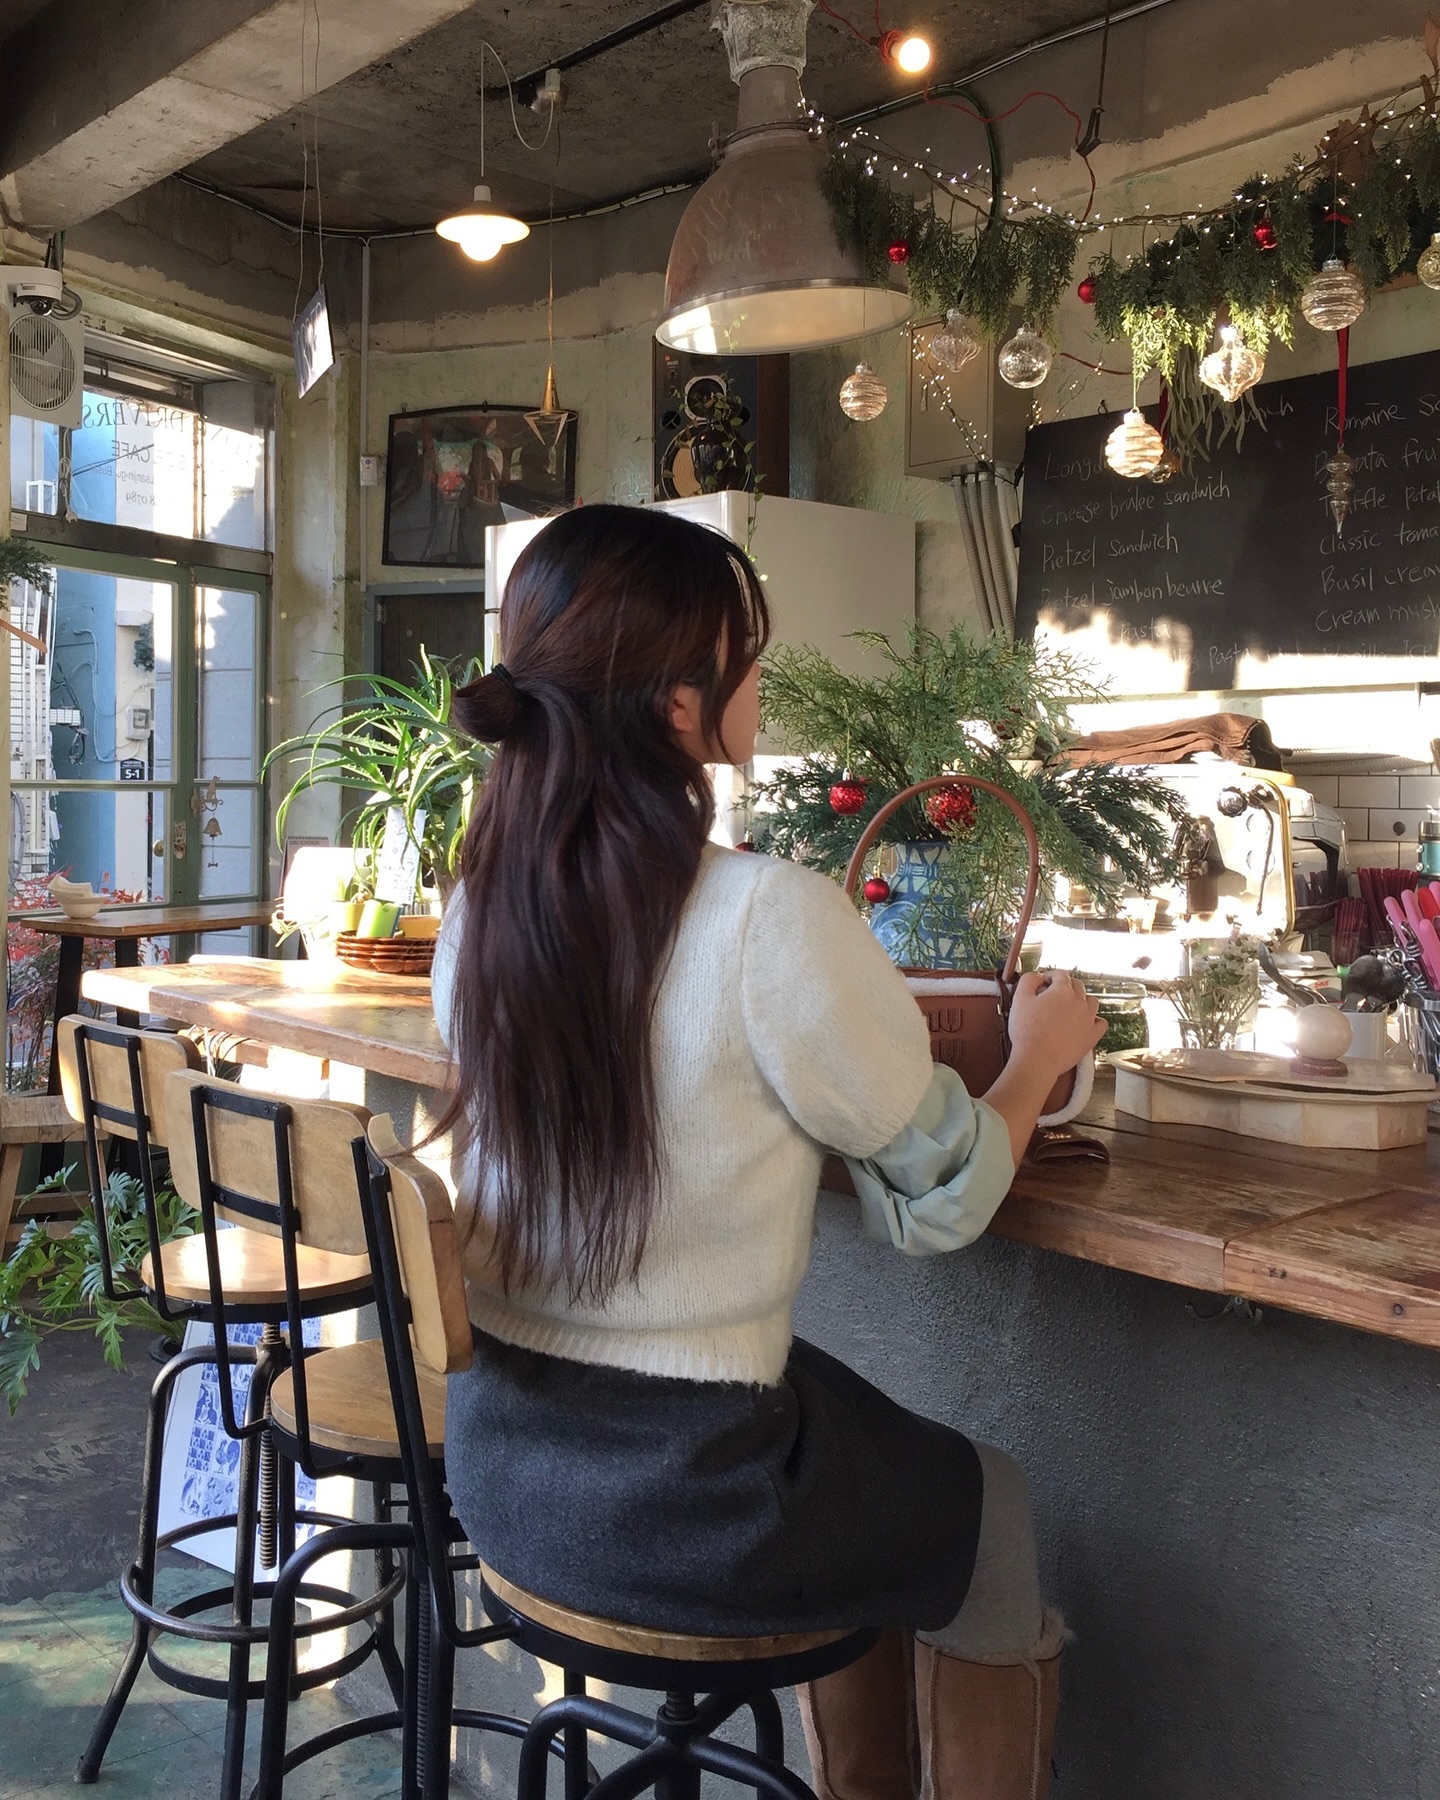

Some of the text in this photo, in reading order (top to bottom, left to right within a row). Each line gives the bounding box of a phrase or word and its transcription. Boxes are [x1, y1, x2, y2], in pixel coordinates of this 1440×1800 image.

[1163, 471, 1231, 506] sandwich
[1042, 535, 1096, 573] Pretzel
[1320, 565, 1373, 595] Basil
[125, 768, 140, 779] 5-1
